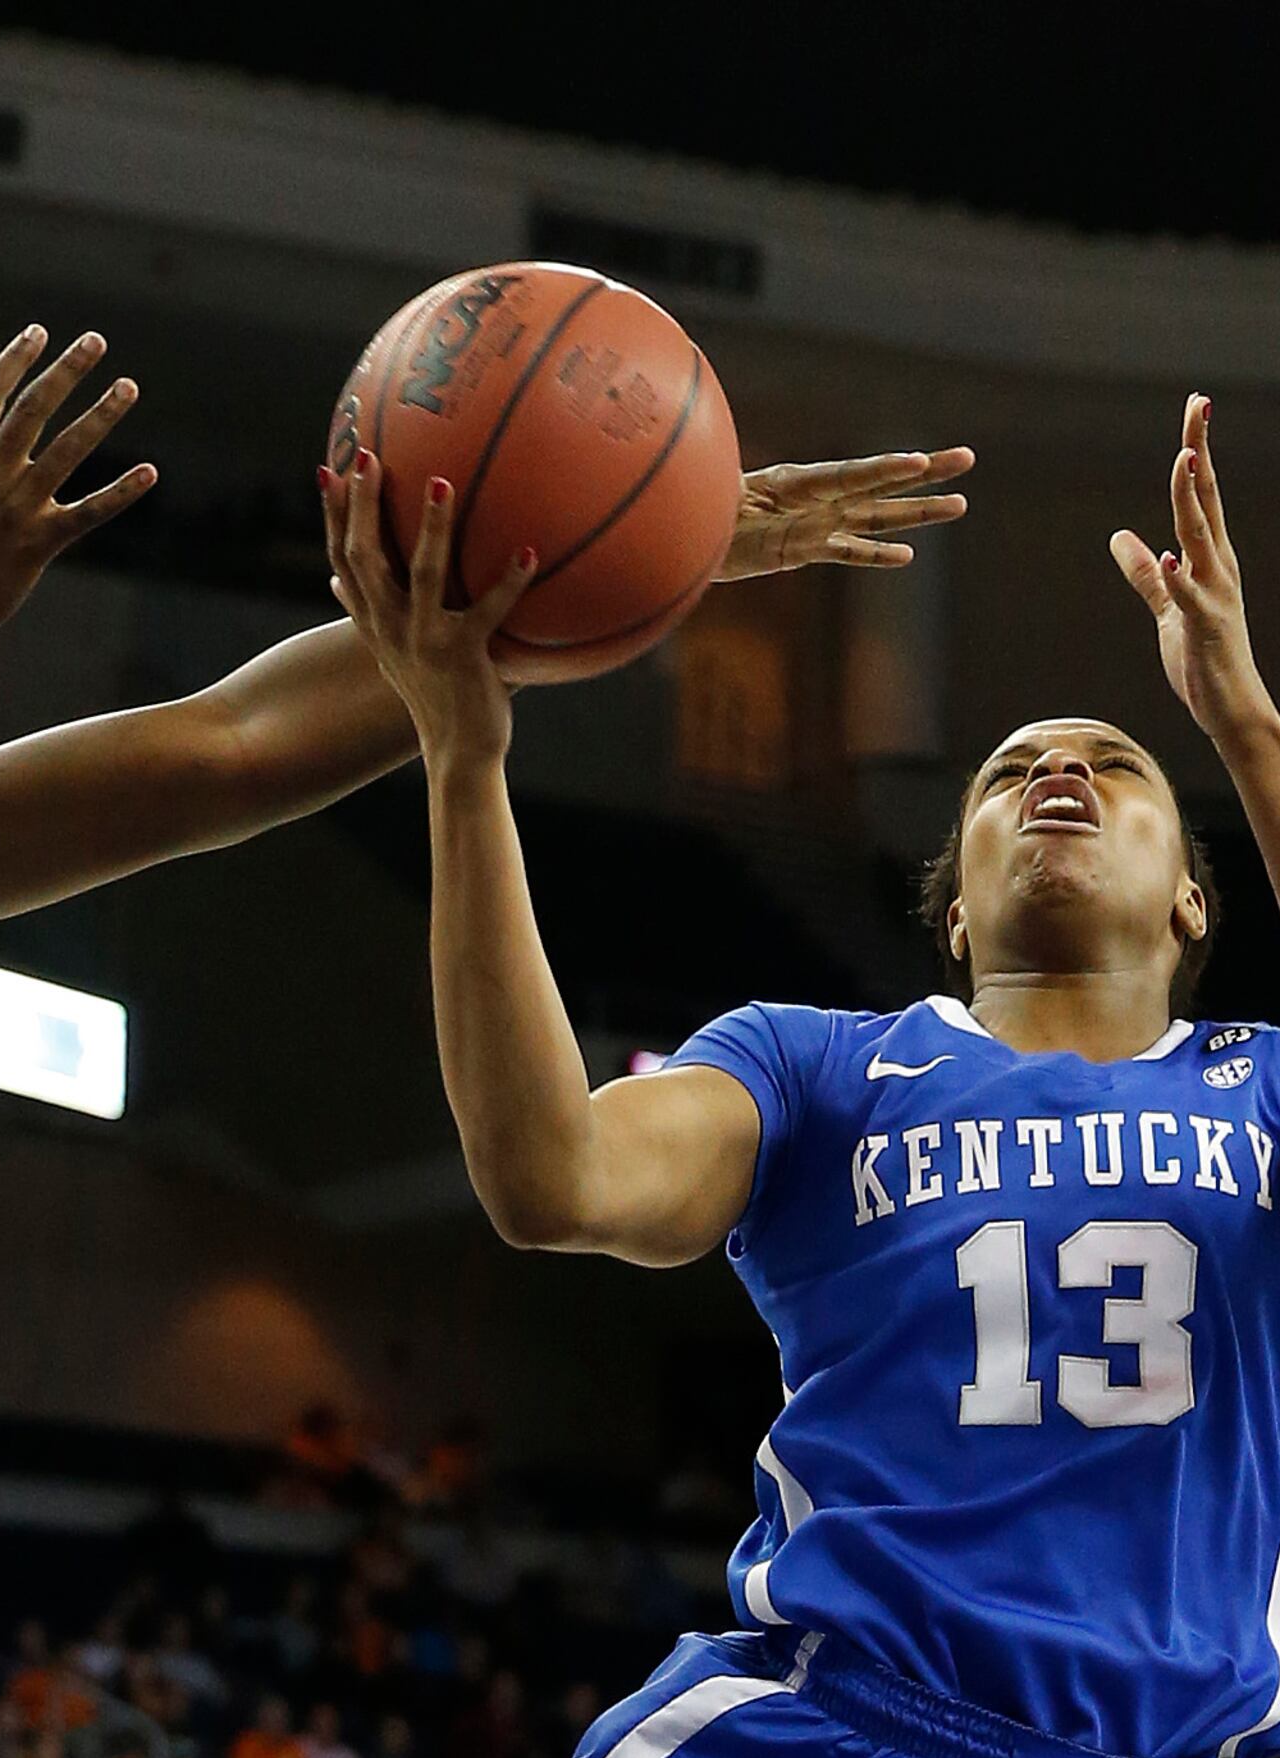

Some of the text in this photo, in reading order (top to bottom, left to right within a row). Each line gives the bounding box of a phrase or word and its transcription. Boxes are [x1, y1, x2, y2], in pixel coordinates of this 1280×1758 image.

[398, 275, 524, 416] NCAA
[1206, 1058, 1251, 1087] SEC
[852, 1111, 1276, 1227] KENTUCKY
[955, 1219, 1199, 1429] 13
